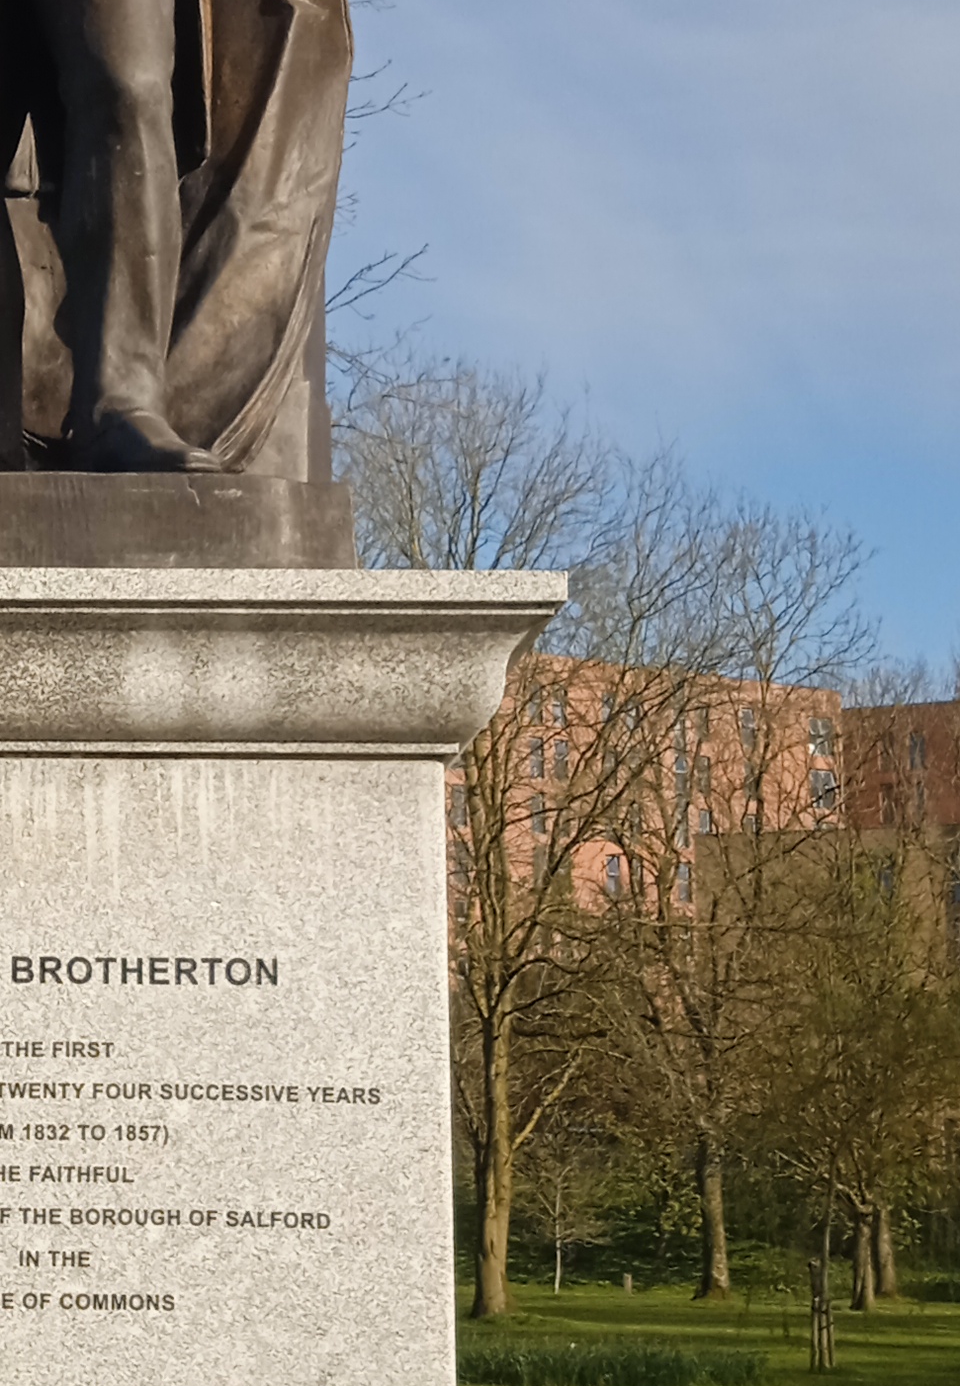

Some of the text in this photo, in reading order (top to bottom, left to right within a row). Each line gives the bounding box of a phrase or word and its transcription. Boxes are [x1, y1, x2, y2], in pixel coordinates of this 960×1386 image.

[11, 956, 279, 986] BROTHERTON
[1, 1041, 115, 1058] THE FIRST
[92, 1084, 153, 1101] FOUR
[160, 1084, 299, 1103] SUCCESSIVE
[307, 1086, 382, 1104] YEARS
[21, 1124, 70, 1142] 1832
[77, 1124, 107, 1142] TO
[115, 1124, 169, 1145] 1857)
[29, 1166, 135, 1184] FAITHFUL
[18, 1208, 62, 1225] THE
[70, 1208, 182, 1227] BOROUGH
[188, 1210, 218, 1228] OF
[225, 1211, 331, 1230] SALFORD
[18, 1251, 91, 1268] IN THE
[21, 1293, 52, 1310] OF
[59, 1293, 175, 1311] COMMONS
